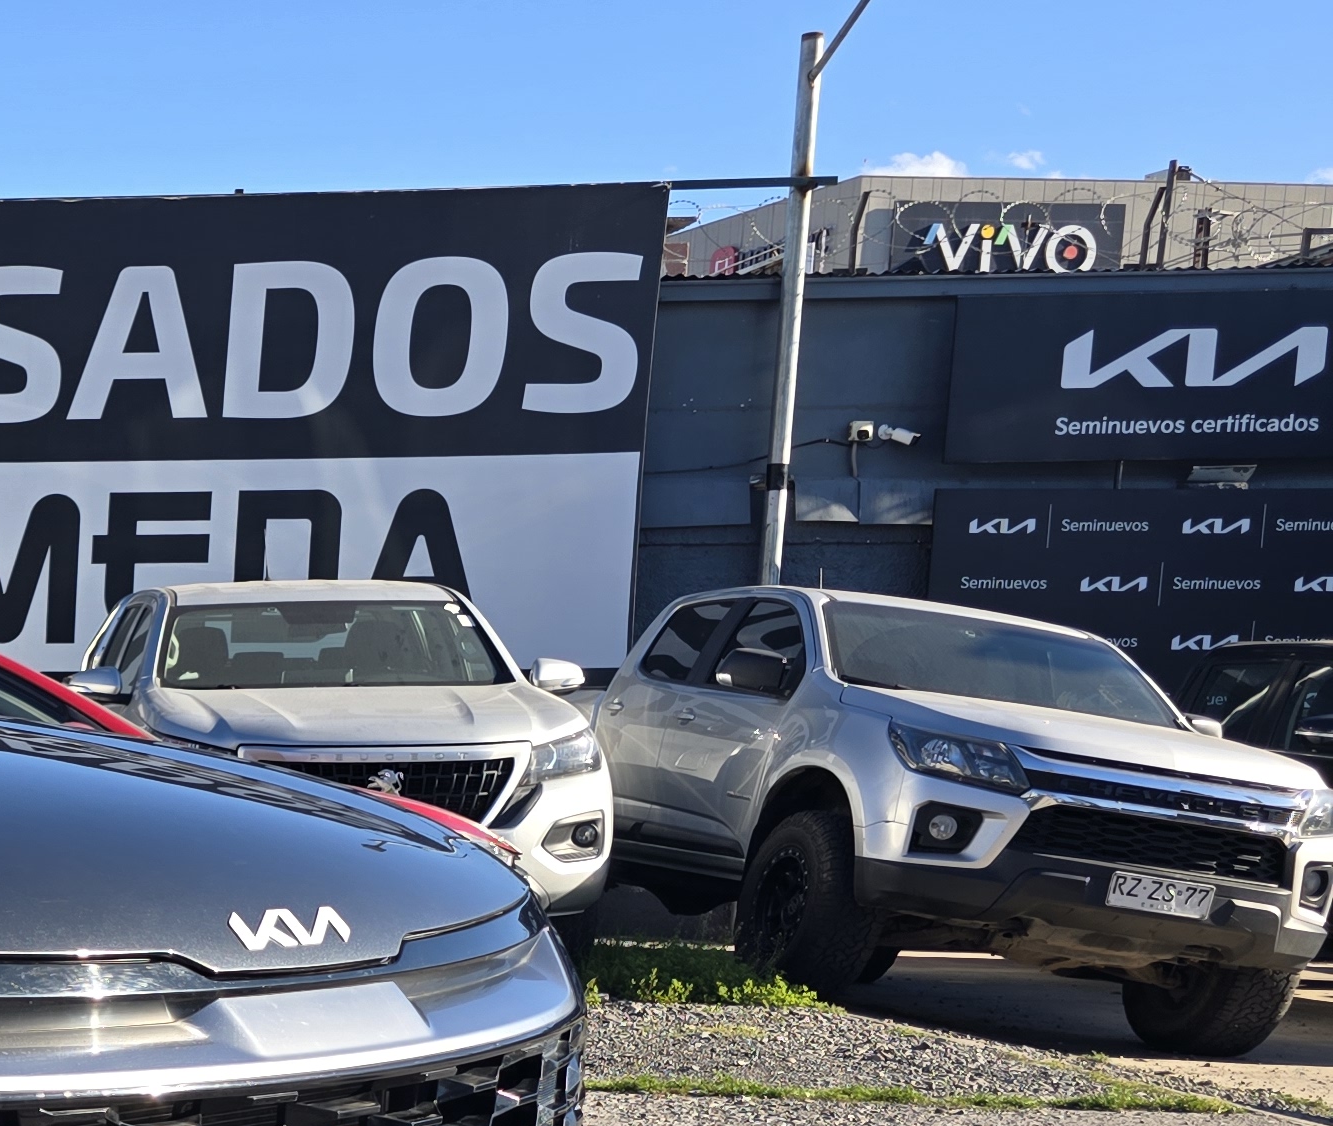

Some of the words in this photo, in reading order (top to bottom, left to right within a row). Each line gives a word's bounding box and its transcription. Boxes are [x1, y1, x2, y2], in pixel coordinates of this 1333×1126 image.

[1054, 416, 1185, 436] Seminuevos
[1190, 413, 1319, 434] certificados
[1060, 518, 1149, 532] Seminuevos
[1275, 518, 1333, 532] Seminu
[960, 576, 1048, 590] Seminuevos
[1172, 576, 1261, 590] Seminuevos
